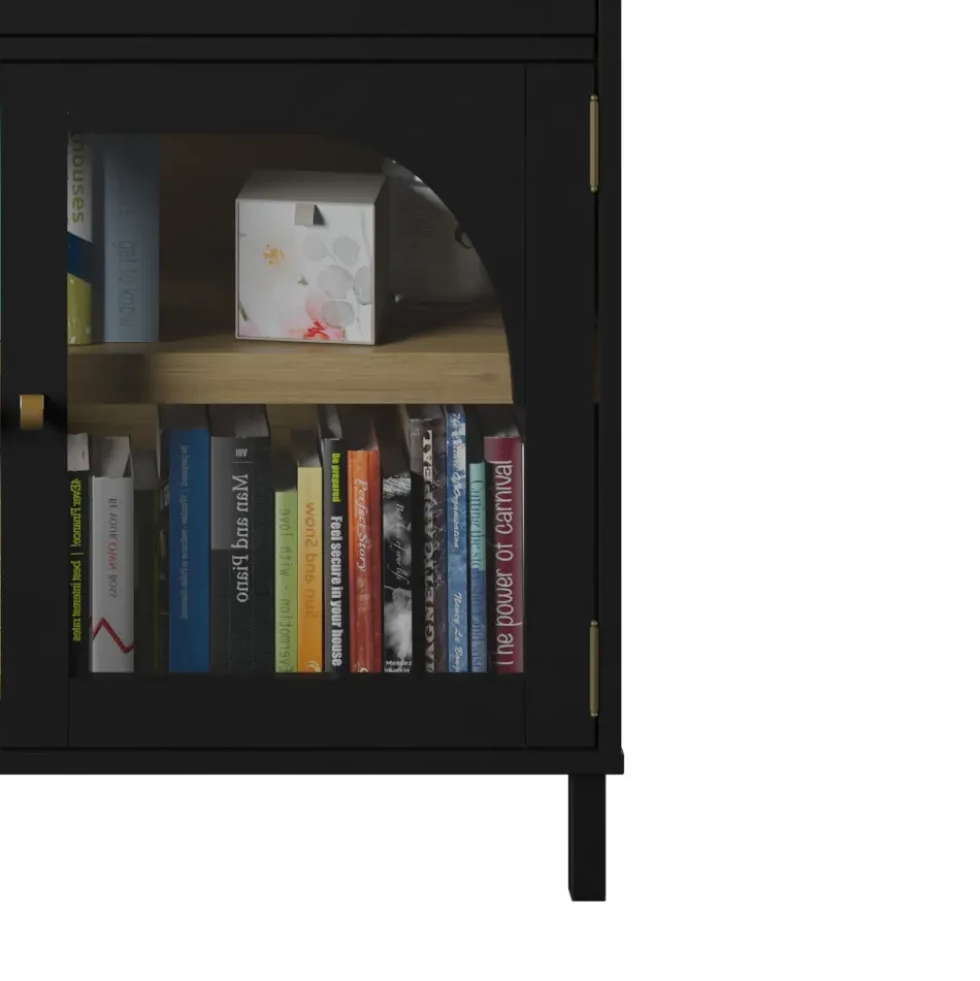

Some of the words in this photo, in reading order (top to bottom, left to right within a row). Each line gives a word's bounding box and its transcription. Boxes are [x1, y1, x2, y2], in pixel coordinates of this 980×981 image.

[331, 465, 341, 502] prepared
[495, 460, 513, 534] carnival
[356, 479, 368, 529] Perfect
[330, 516, 343, 540] Feel
[330, 543, 343, 584] secure
[356, 531, 368, 572] Story
[491, 542, 513, 561] of
[330, 587, 343, 598] in
[495, 568, 523, 626] power
[330, 601, 341, 627] your
[330, 629, 343, 667] house
